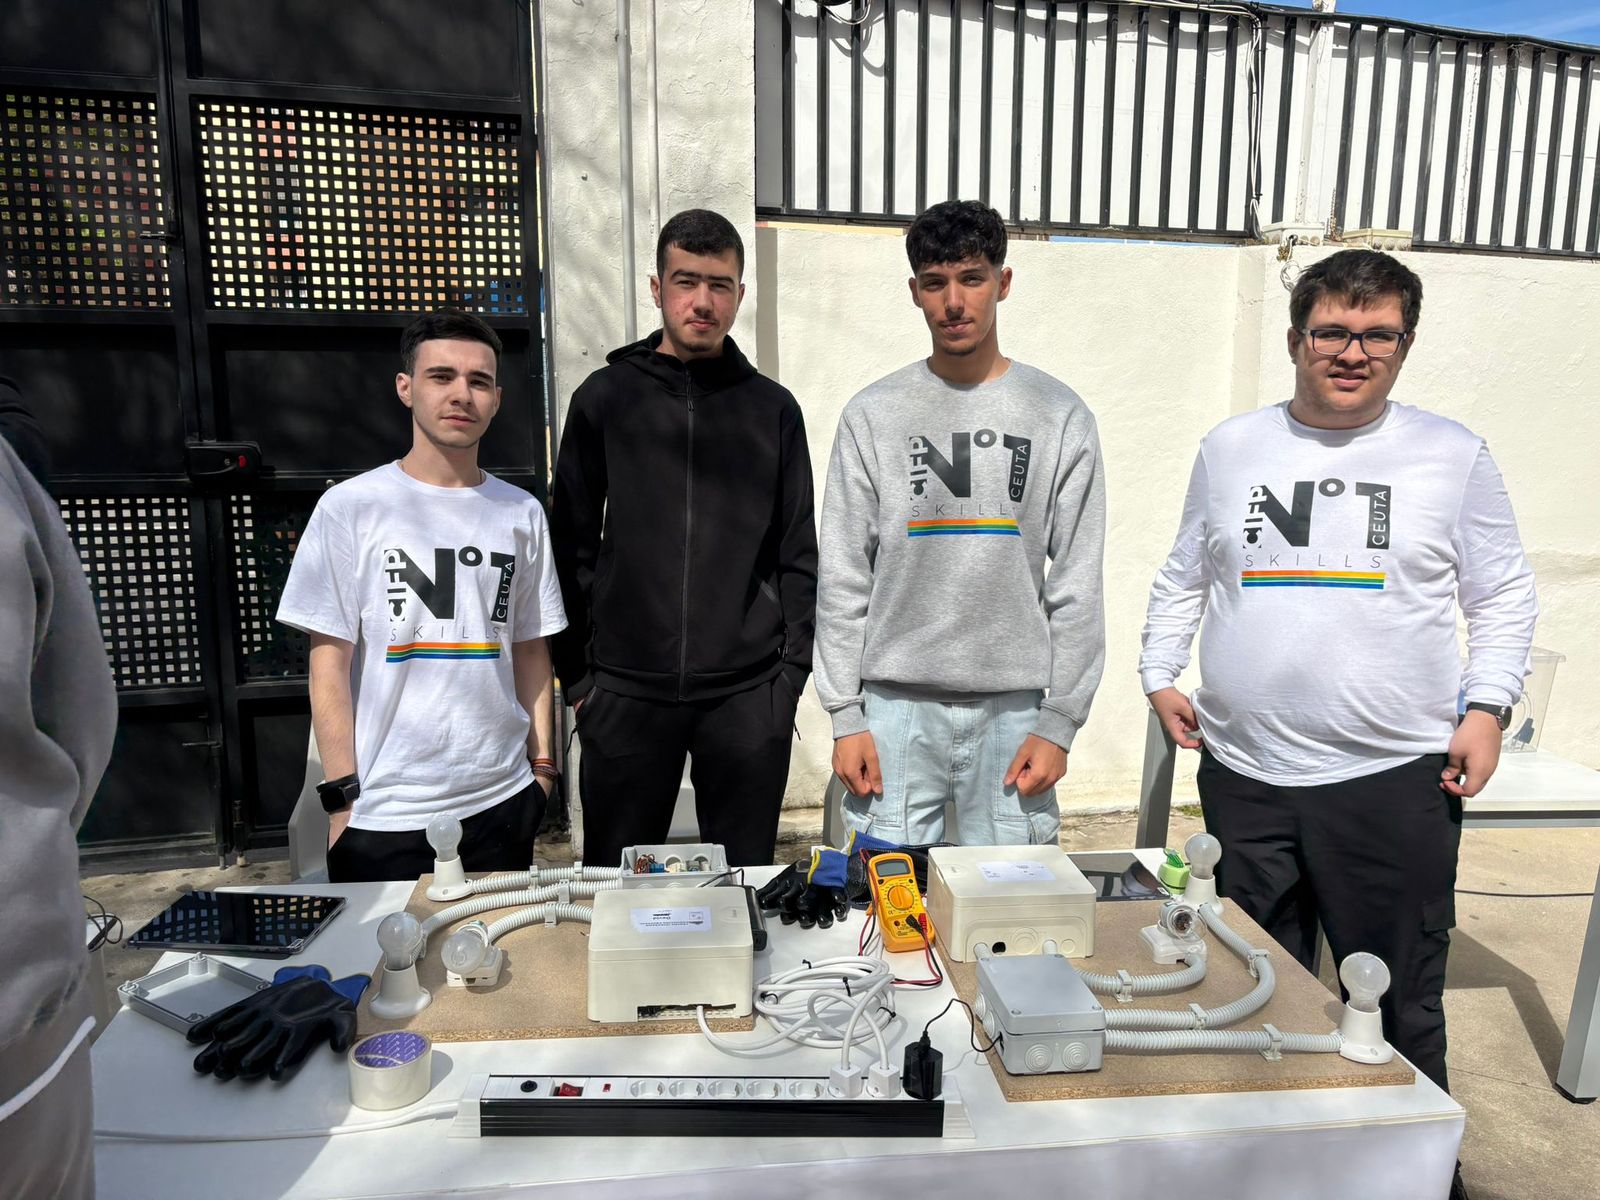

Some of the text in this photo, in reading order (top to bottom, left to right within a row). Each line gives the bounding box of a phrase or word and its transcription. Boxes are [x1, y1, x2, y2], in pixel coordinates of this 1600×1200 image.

[1010, 444, 1028, 498] CEUTA
[911, 503, 1016, 517] SKILL
[1372, 490, 1388, 546] CEUTA
[1244, 553, 1382, 569] SKILLS
[496, 561, 514, 619] CEUTA
